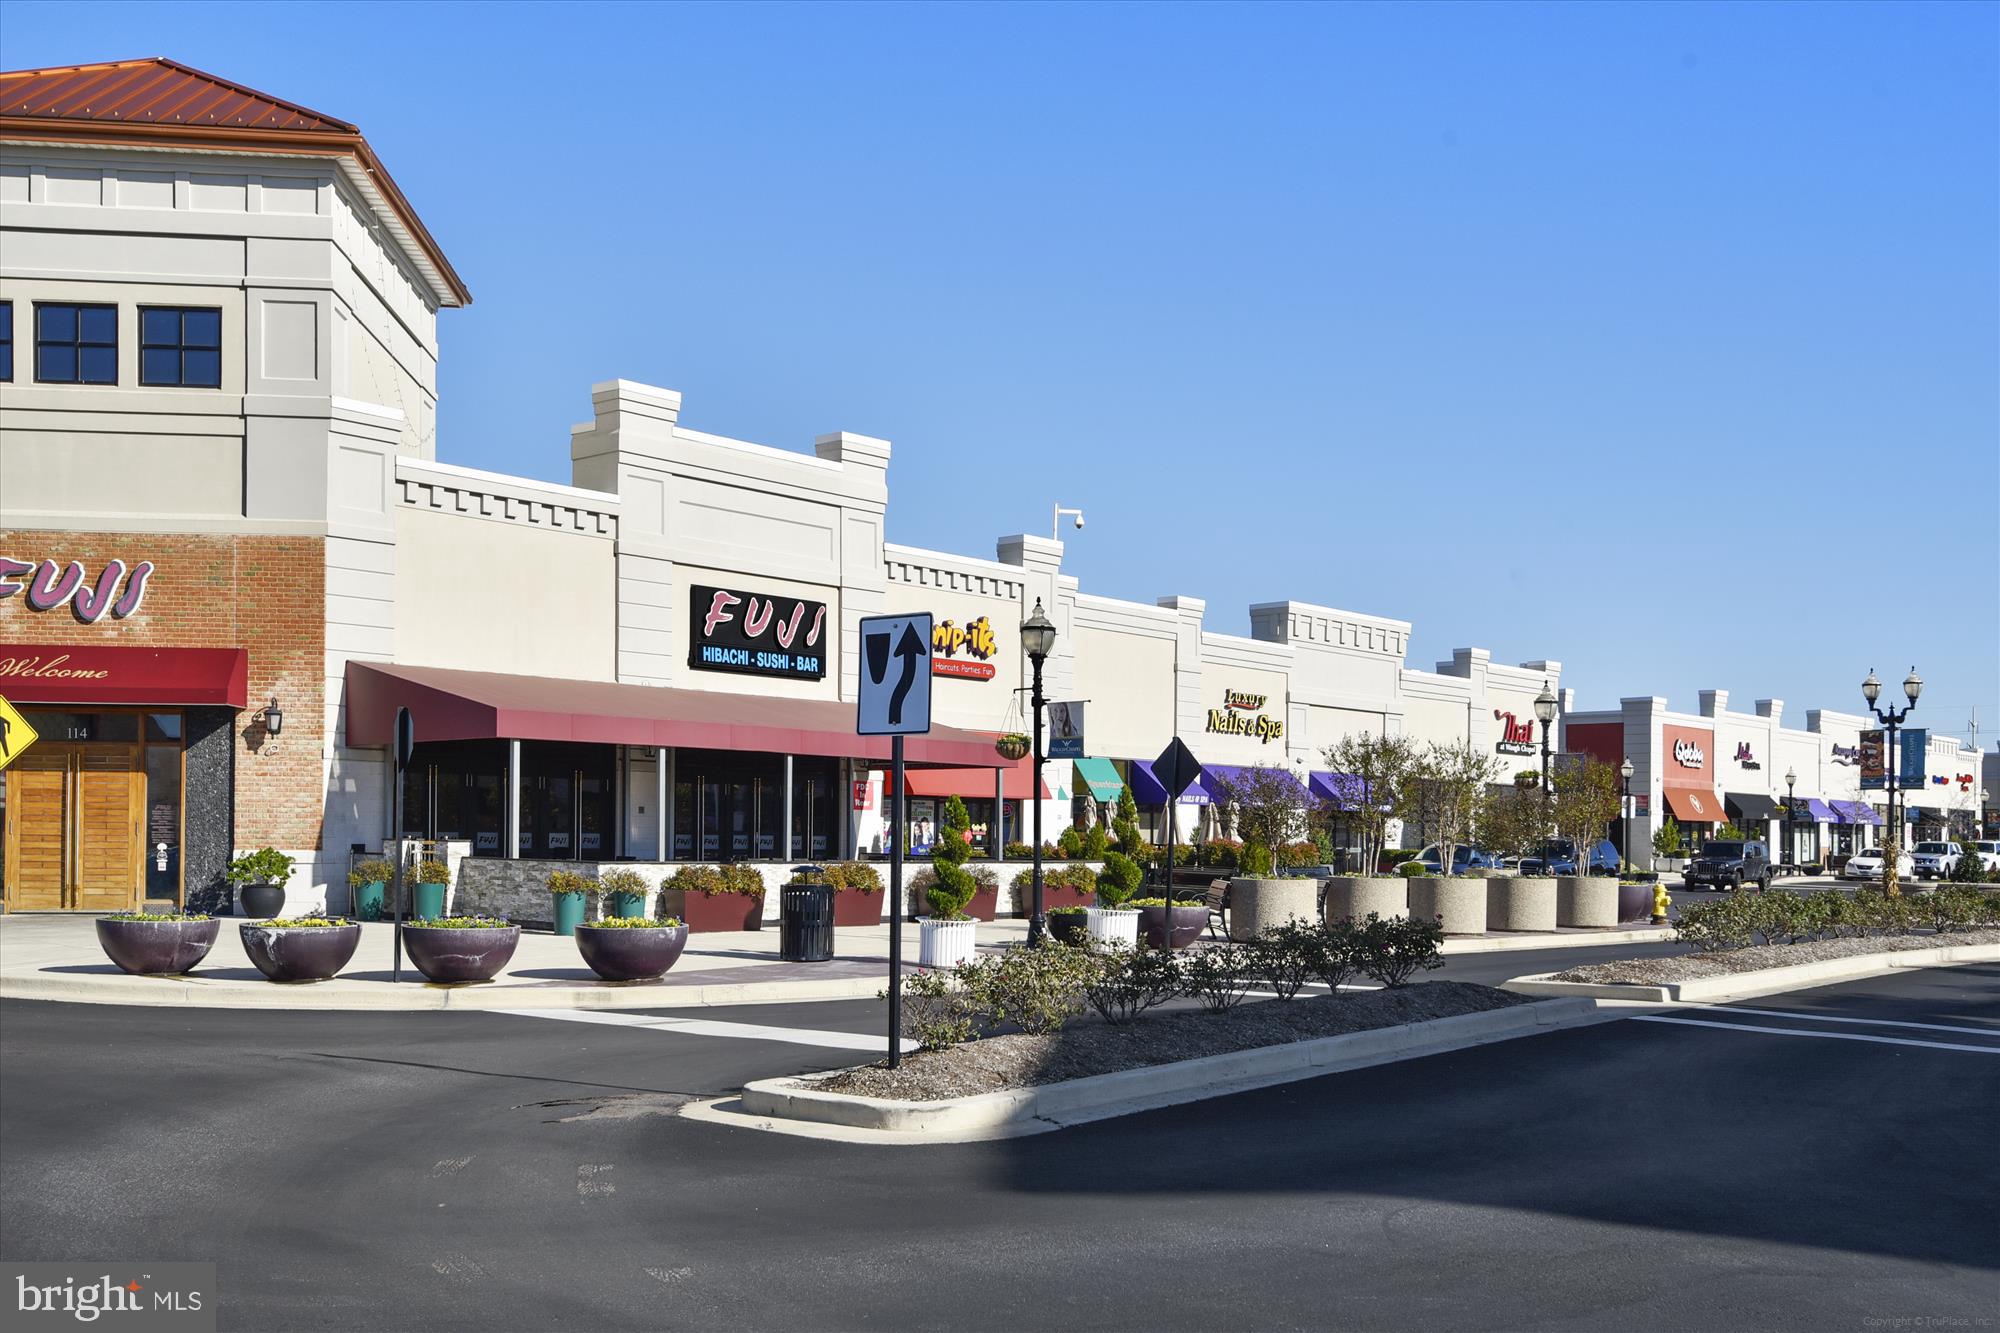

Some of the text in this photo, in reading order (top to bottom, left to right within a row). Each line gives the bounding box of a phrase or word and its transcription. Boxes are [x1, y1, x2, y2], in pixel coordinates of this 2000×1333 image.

[704, 590, 826, 648] FUJI
[932, 616, 997, 660] nip-its
[0, 654, 109, 679] Welcome
[703, 646, 749, 665] HIBACHI
[756, 651, 789, 669] SUSHI
[796, 656, 819, 672] BAR
[1224, 688, 1267, 706] Luxury
[68, 727, 88, 739] 114
[1206, 709, 1247, 735] Nails
[1256, 714, 1283, 744] Spa
[1494, 709, 1533, 743] Thai
